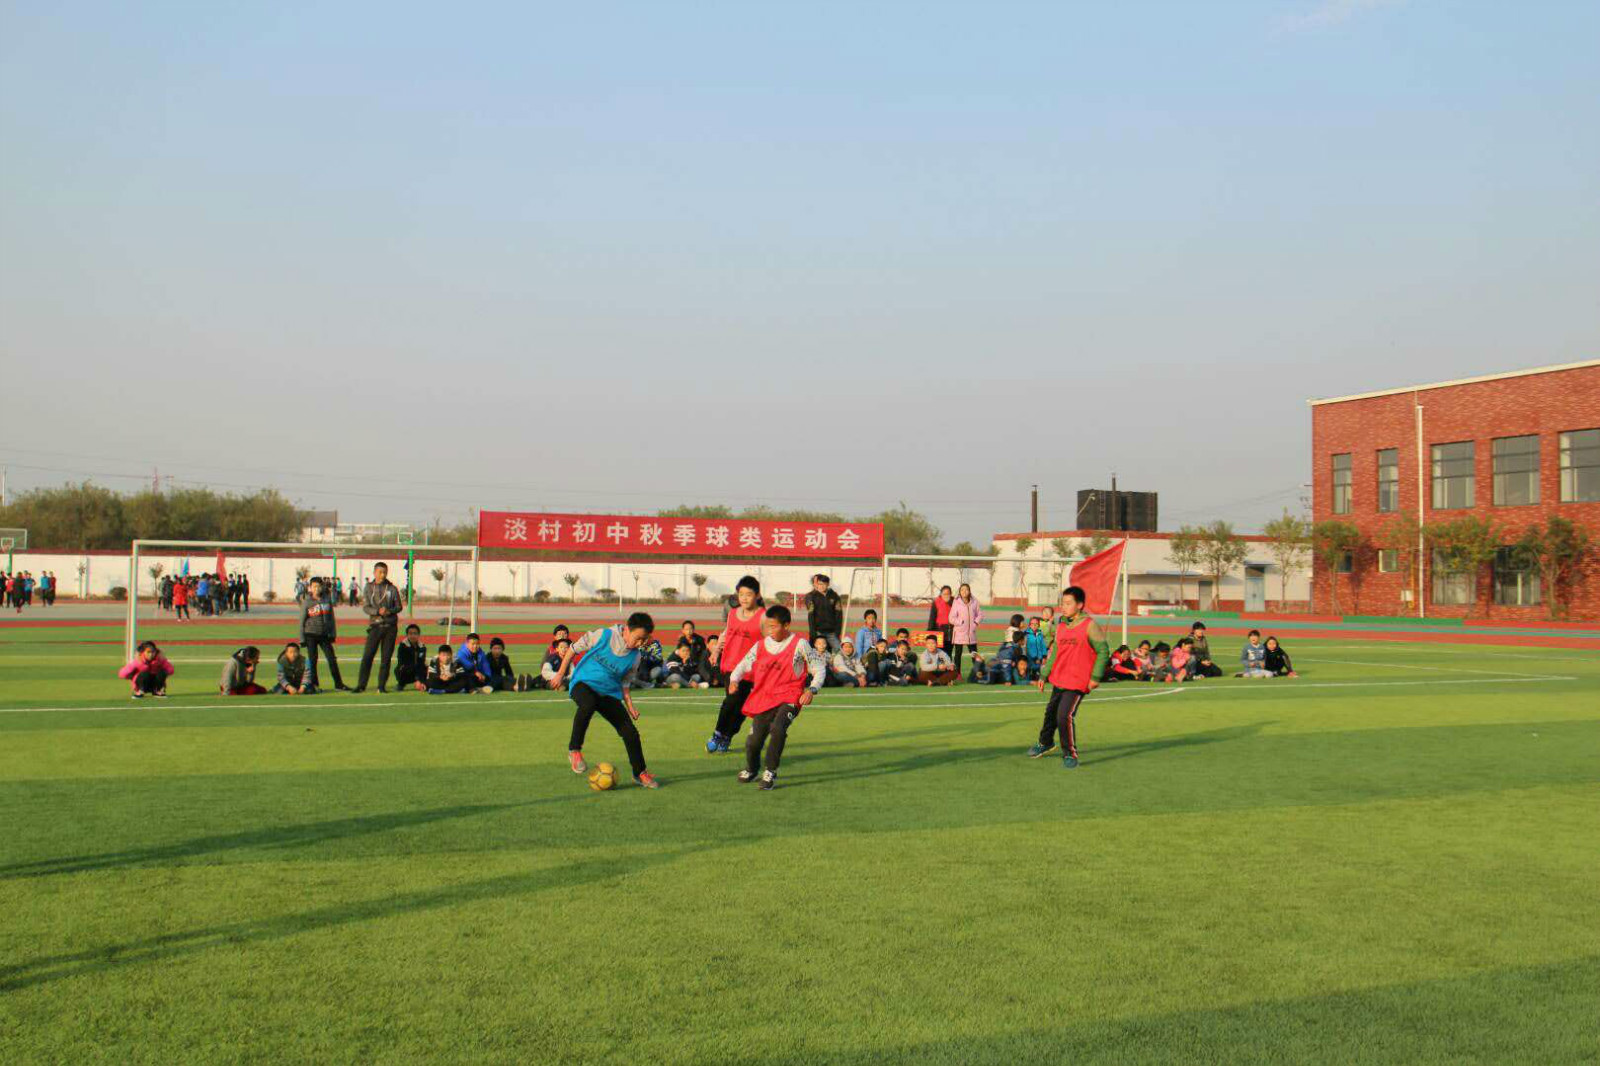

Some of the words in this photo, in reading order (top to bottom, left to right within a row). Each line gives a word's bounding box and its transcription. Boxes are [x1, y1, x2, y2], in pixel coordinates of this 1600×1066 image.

[504, 518, 861, 550] 淡村初中秋季球类运动会
